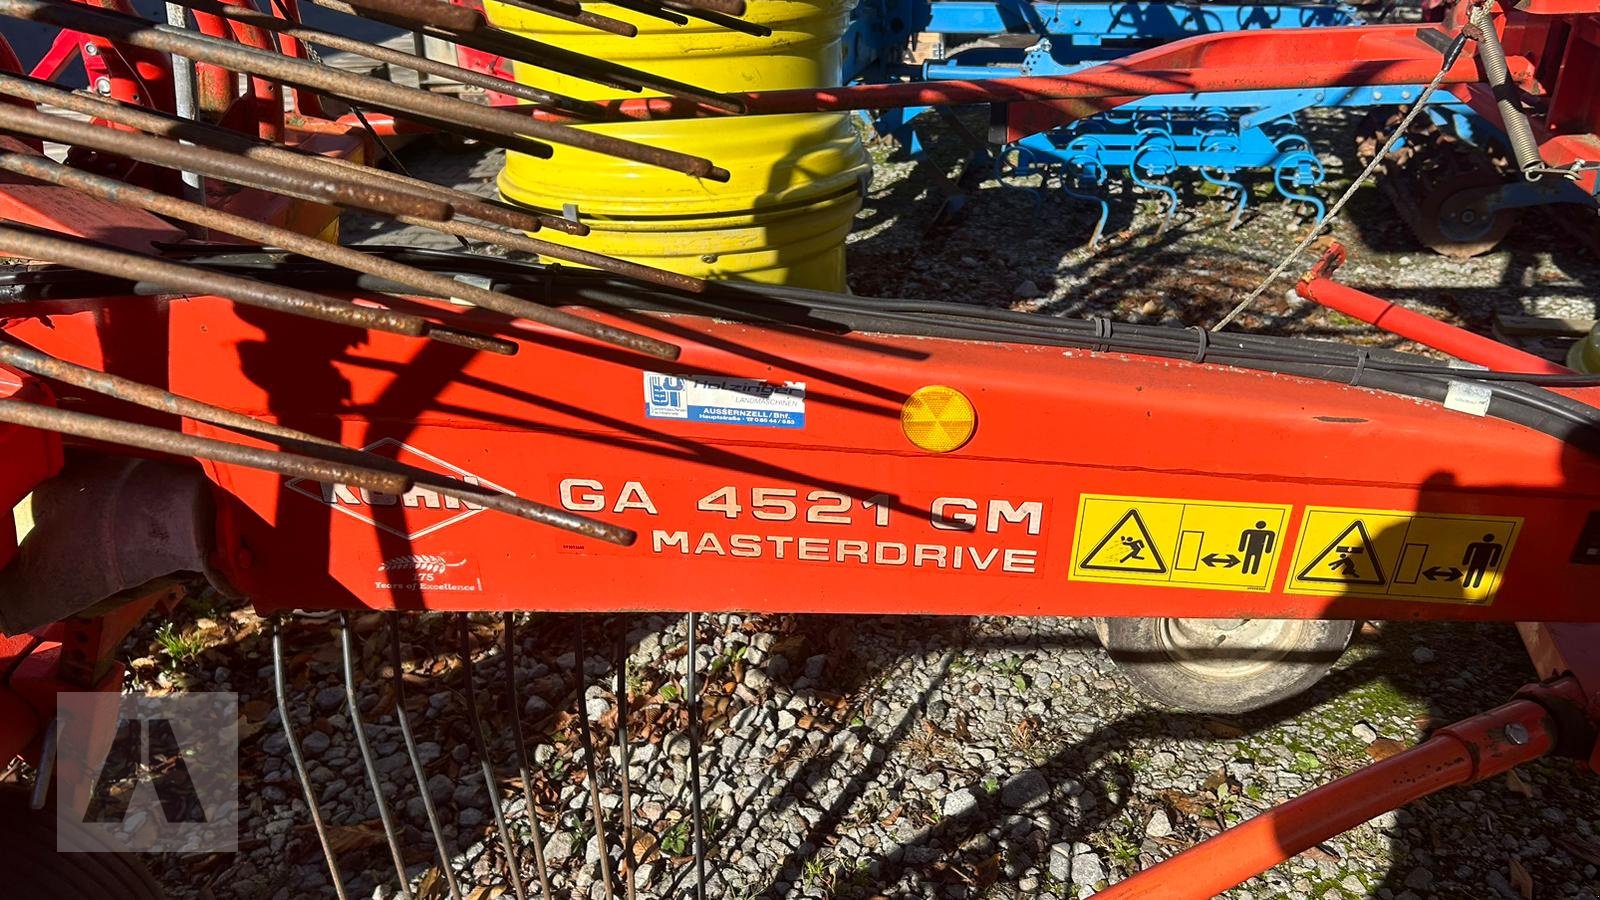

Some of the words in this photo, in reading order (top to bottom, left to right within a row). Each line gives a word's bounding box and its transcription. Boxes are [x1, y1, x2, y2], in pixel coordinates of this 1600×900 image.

[735, 396, 798, 407] LANDMASCHINEN
[559, 478, 658, 515] GA
[696, 486, 890, 527] 4521
[930, 497, 1044, 535] GM
[652, 529, 1038, 573] MASTERDRIVE
[420, 583, 475, 591] Excellence
